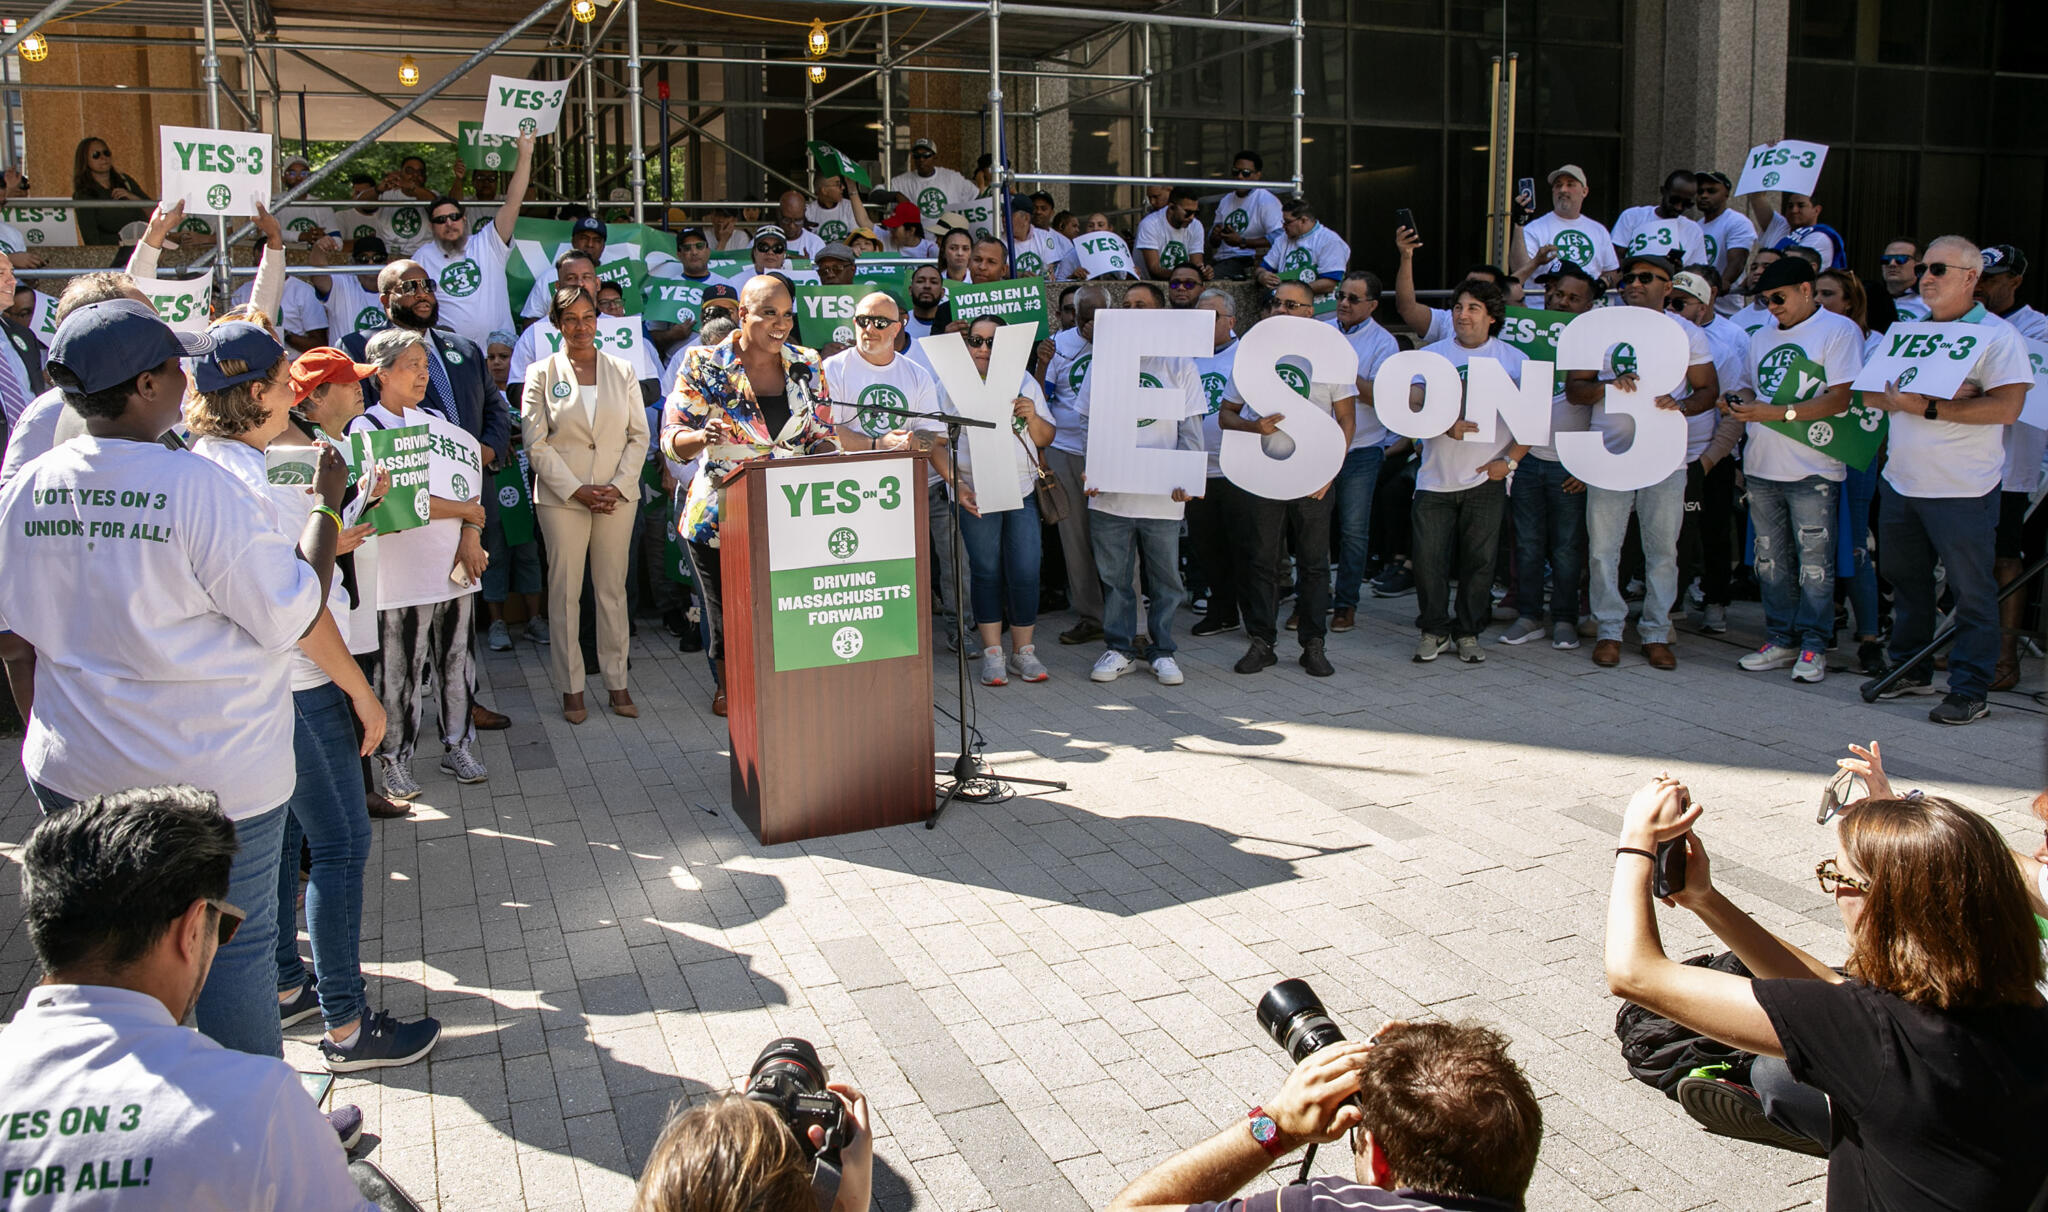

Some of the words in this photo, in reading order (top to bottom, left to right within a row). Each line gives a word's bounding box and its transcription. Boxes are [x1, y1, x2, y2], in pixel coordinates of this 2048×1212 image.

[499, 87, 545, 110] YES
[551, 90, 562, 108] 3
[173, 142, 235, 173] YES
[248, 147, 263, 175] 3
[1752, 148, 1791, 169] YES
[1799, 151, 1816, 168] 3
[1, 207, 44, 222] YES
[1082, 237, 1119, 255] YES
[1562, 234, 1584, 246] YES
[1658, 228, 1672, 245] 3
[1569, 245, 1580, 261] 3
[613, 266, 628, 278] LA
[955, 291, 989, 306] VOTA
[1004, 287, 1021, 300] EN
[1023, 285, 1040, 297] LA
[153, 294, 193, 323] ES
[803, 295, 855, 319] YES
[957, 301, 1022, 320] PREGUNTA
[1024, 299, 1041, 311] #3
[616, 328, 633, 349] 3
[1498, 317, 1536, 343] ES
[1888, 334, 1944, 358] YES
[1948, 336, 1977, 360] 3
[870, 390, 897, 407] YES
[919, 308, 1359, 513] YES
[1374, 350, 1554, 446] ON
[1555, 305, 1690, 491] 3
[1860, 407, 1883, 432] 3
[79, 489, 116, 507] YES
[120, 490, 150, 508] ON
[153, 493, 168, 510] 3
[781, 480, 861, 517] YES
[862, 490, 877, 499] ON
[879, 476, 901, 510] 3
[89, 521, 125, 538] FOR
[130, 523, 171, 543] ALL!
[835, 531, 851, 541] YES
[813, 571, 876, 590] DRIVING
[778, 584, 911, 611] MASSACHUSETTS
[808, 605, 884, 626] FORWARD
[843, 640, 852, 652] 3
[59, 1105, 110, 1136] ON
[119, 1103, 142, 1132] 3
[2, 1165, 65, 1198] FOR
[74, 1157, 153, 1192] ALL!
